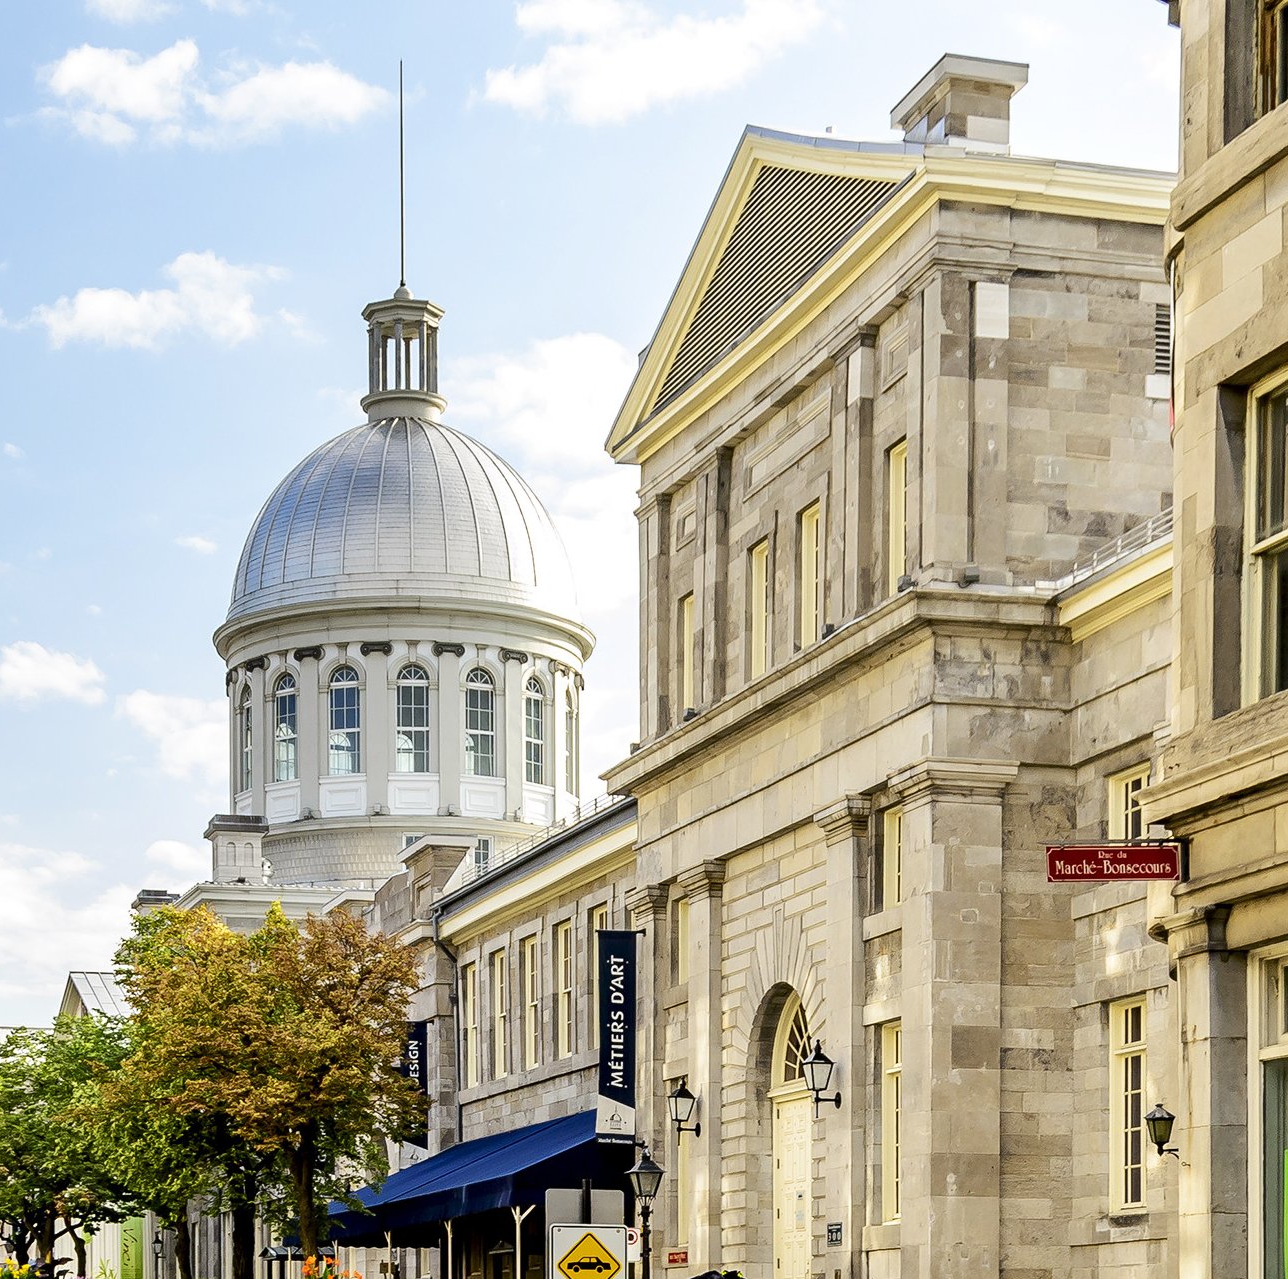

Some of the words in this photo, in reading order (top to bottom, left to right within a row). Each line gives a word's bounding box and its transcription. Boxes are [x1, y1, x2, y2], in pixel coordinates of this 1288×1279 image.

[1055, 859, 1171, 875] Marché-Bonsecours
[1098, 850, 1113, 859] Rue
[1117, 850, 1127, 859] du
[609, 954, 625, 1004] D'ART
[608, 1010, 625, 1088] MÉTIERS
